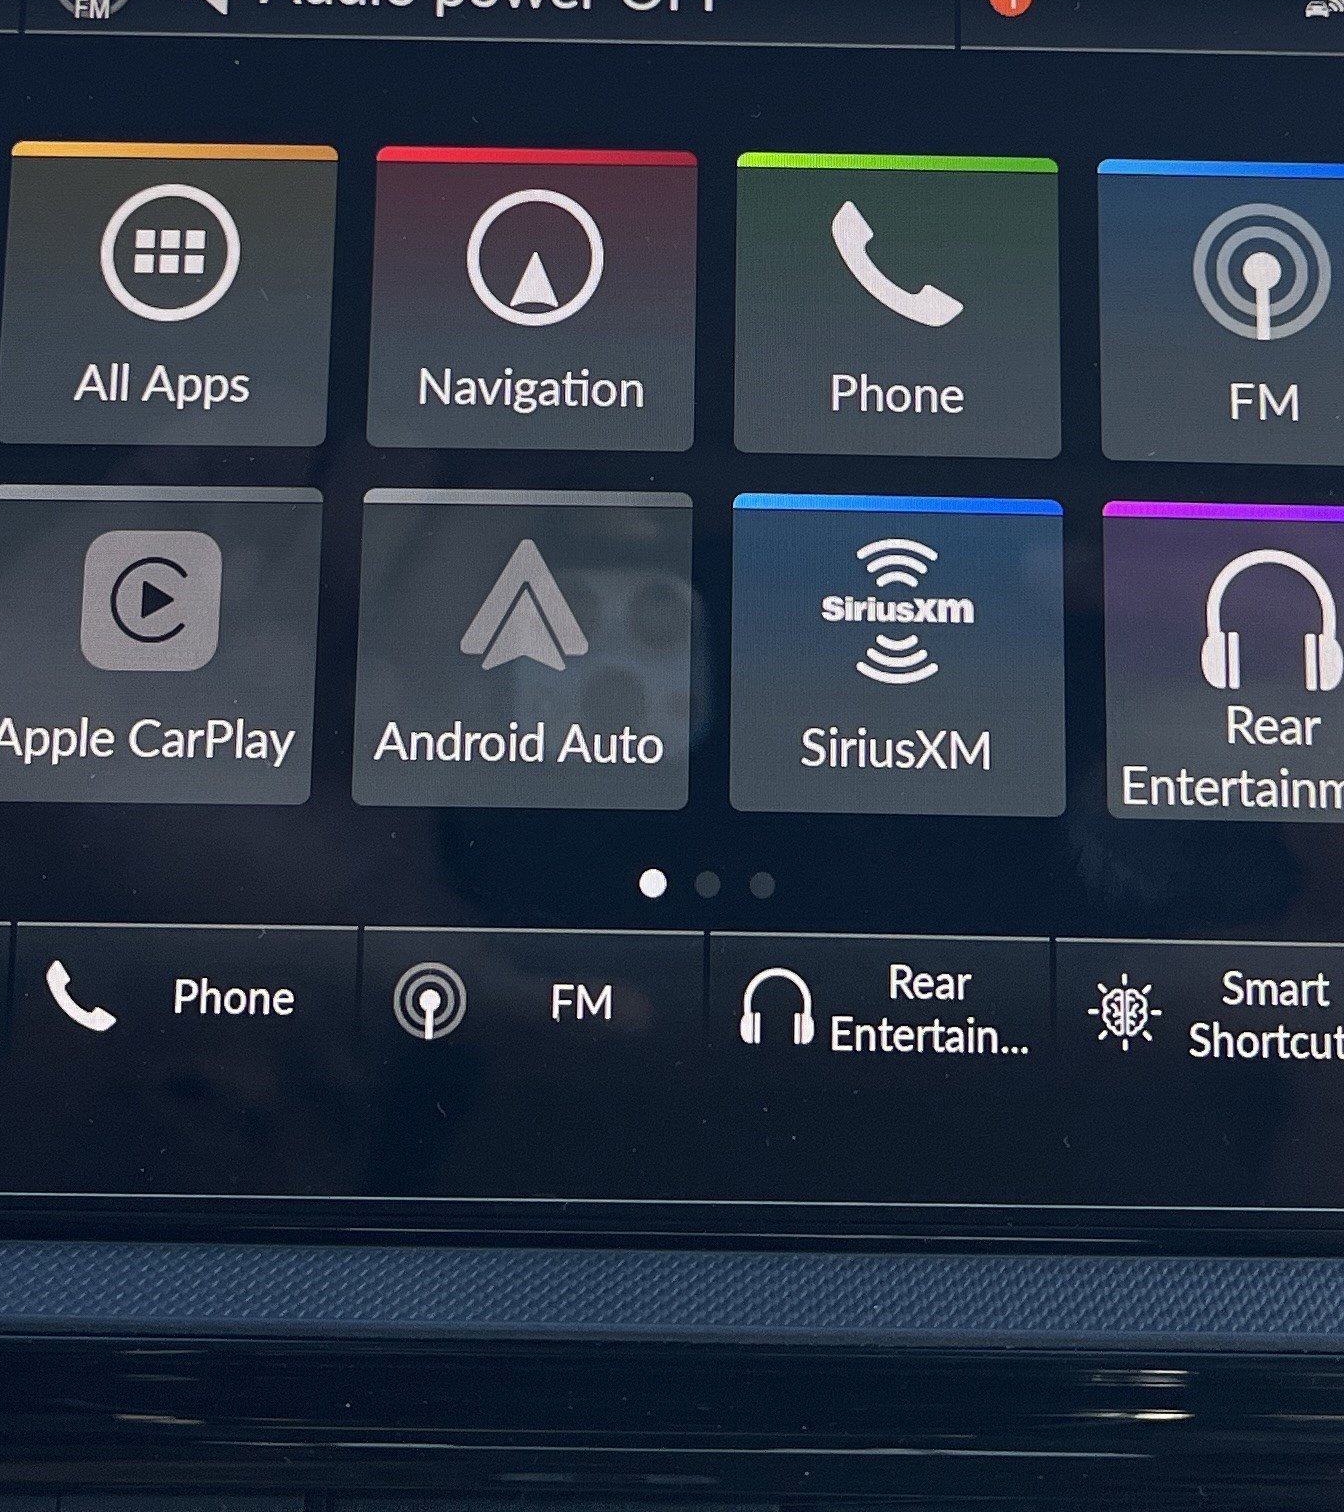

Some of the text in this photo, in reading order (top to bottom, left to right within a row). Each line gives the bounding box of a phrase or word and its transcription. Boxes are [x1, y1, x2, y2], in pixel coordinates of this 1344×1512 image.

[73, 362, 250, 410] All Apps
[419, 367, 644, 414] Navigation
[832, 373, 964, 414] Phone
[1230, 382, 1299, 422] FM
[128, 718, 296, 768] CarPlay
[373, 720, 664, 764] Android Auto
[1227, 705, 1322, 746] Rear
[801, 726, 990, 771] SiriusXM
[174, 977, 295, 1016] Phone
[552, 983, 612, 1021] FM
[890, 964, 973, 1001] Rear
[1222, 970, 1331, 1007] Smart
